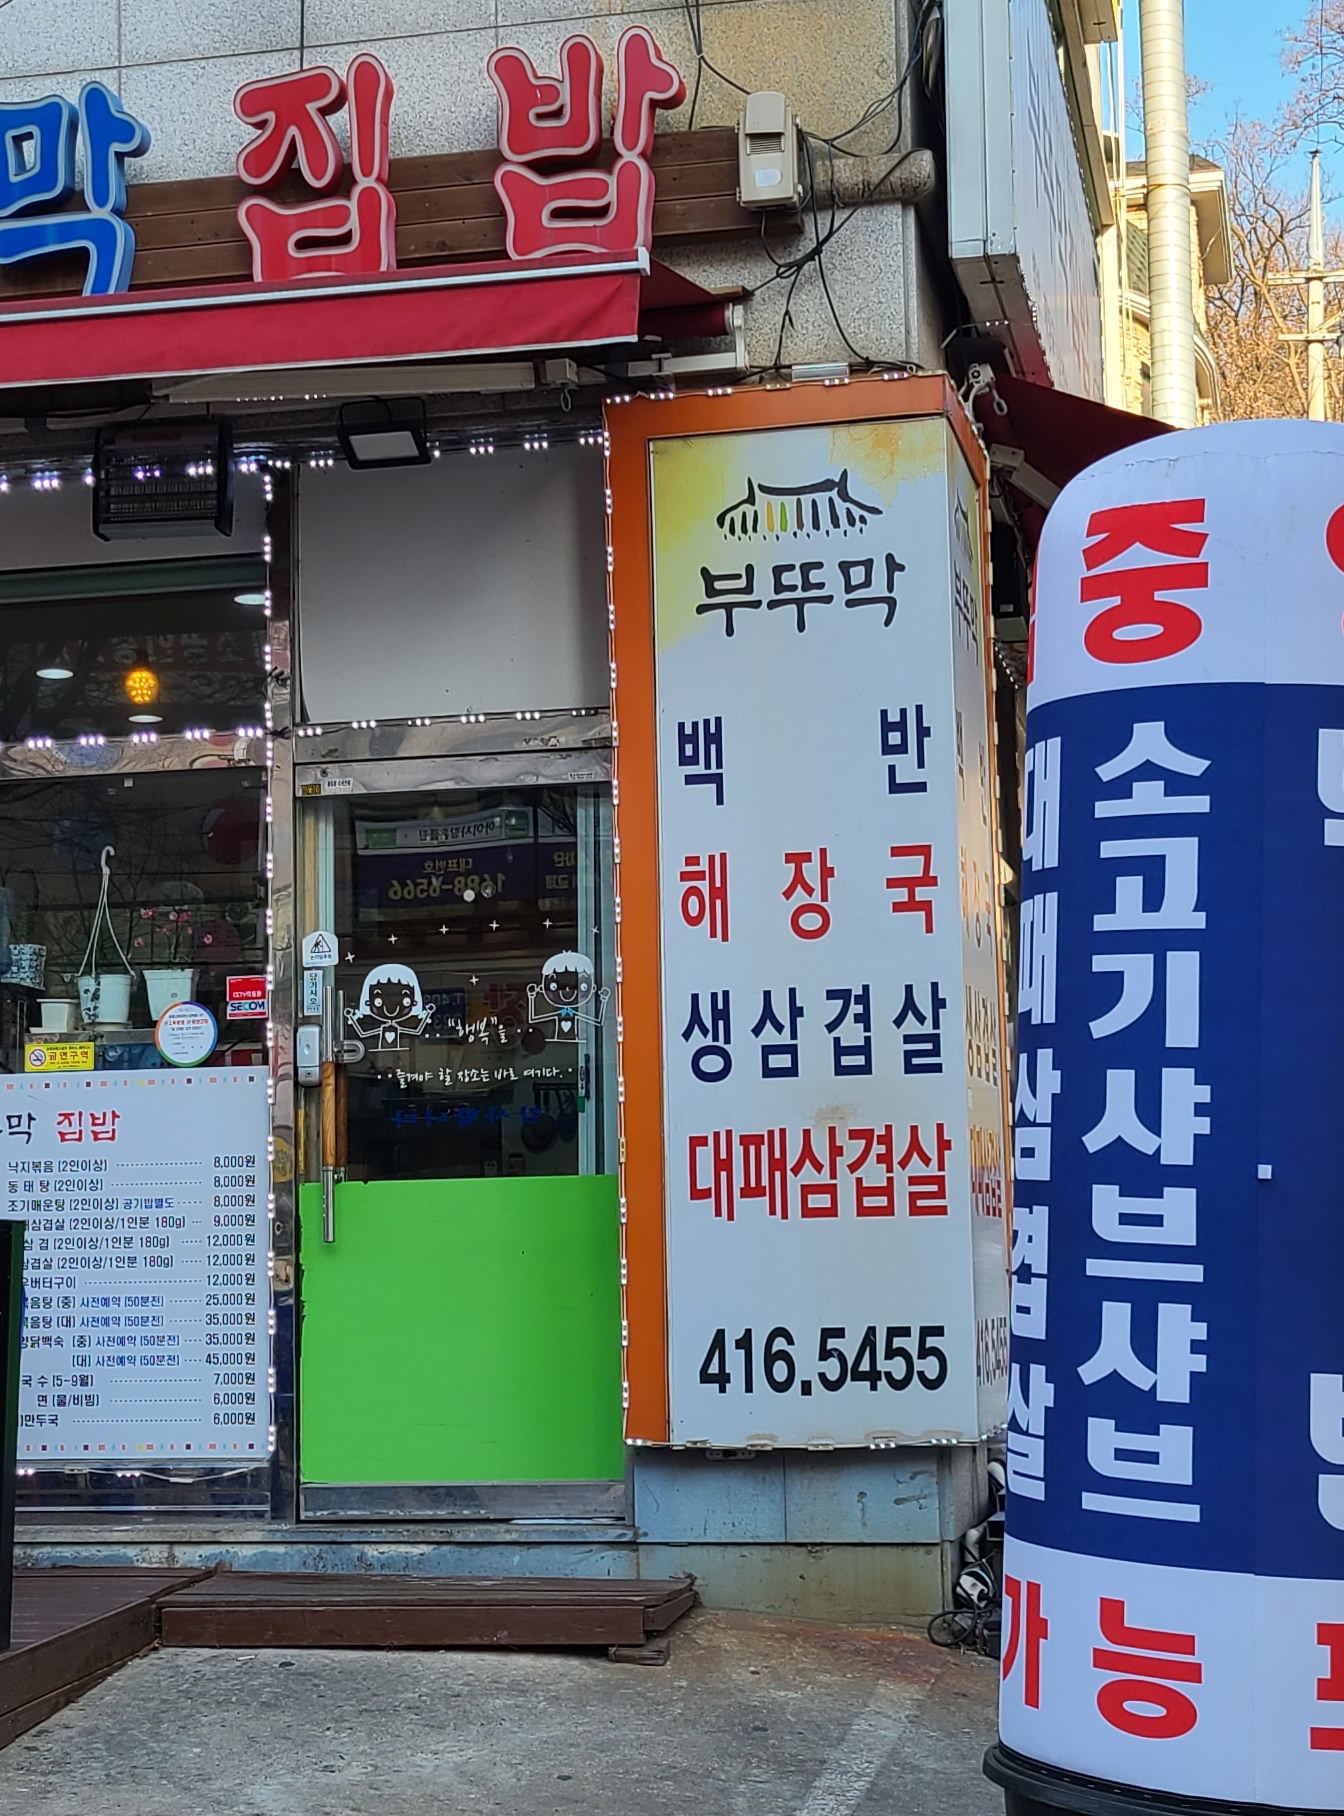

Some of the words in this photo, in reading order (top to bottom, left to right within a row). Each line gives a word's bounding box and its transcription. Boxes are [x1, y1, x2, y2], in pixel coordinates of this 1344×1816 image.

[233, 25, 687, 282] 집밥
[695, 552, 906, 637] 부뚜막
[230, 1001, 265, 1012] SECOM
[681, 981, 947, 1082] 생삼겹살
[49, 1050, 89, 1061] 금연구역
[457, 1068, 491, 1083] 장소는
[56, 1110, 121, 1143] 집밥
[1076, 720, 1212, 1524] 소고기샤브샤브
[7, 1160, 54, 1174] 낙지볶음
[58, 1158, 108, 1173] (2인이상)
[213, 1155, 256, 1168] 8,000원
[688, 1122, 952, 1222] 대패삼겹살
[54, 1178, 104, 1192] (2인이상)
[213, 1175, 256, 1188] 8,000원
[7, 1198, 65, 1213] 조기매운탕
[69, 1198, 119, 1212] (2인이상)
[123, 1197, 175, 1210] 공기밥별도
[213, 1194, 256, 1208] 8,000원
[213, 1213, 256, 1227] 9,000원
[206, 1233, 256, 1247] 12,000원
[206, 1253, 256, 1267] 12,000원
[206, 1273, 256, 1286] 12,000원
[56, 1296, 76, 1310] (중)
[80, 1295, 122, 1309] 사전예약
[124, 1295, 164, 1309] (50분전)
[205, 1292, 256, 1306] 25,000원
[56, 1315, 76, 1329] (대)
[80, 1315, 122, 1328] 사전예약
[124, 1314, 164, 1328] (50분전)
[205, 1312, 256, 1326] 35,000원
[72, 1335, 92, 1349] (중)
[95, 1335, 137, 1348] 사전예약
[139, 1334, 180, 1347] (50분전)
[205, 1332, 256, 1346] 35,000원
[72, 1354, 92, 1368] (대)
[95, 1354, 137, 1368] 사전예약
[139, 1354, 180, 1368] (50분전)
[205, 1352, 256, 1366] 45,000원
[699, 1325, 948, 1396] 416.5455
[52, 1374, 94, 1388] (5~9월)
[213, 1372, 256, 1386] 7,000원
[52, 1393, 100, 1407] (물/비빔)
[213, 1392, 256, 1405] 6,000원
[213, 1412, 256, 1426] 6,000원
